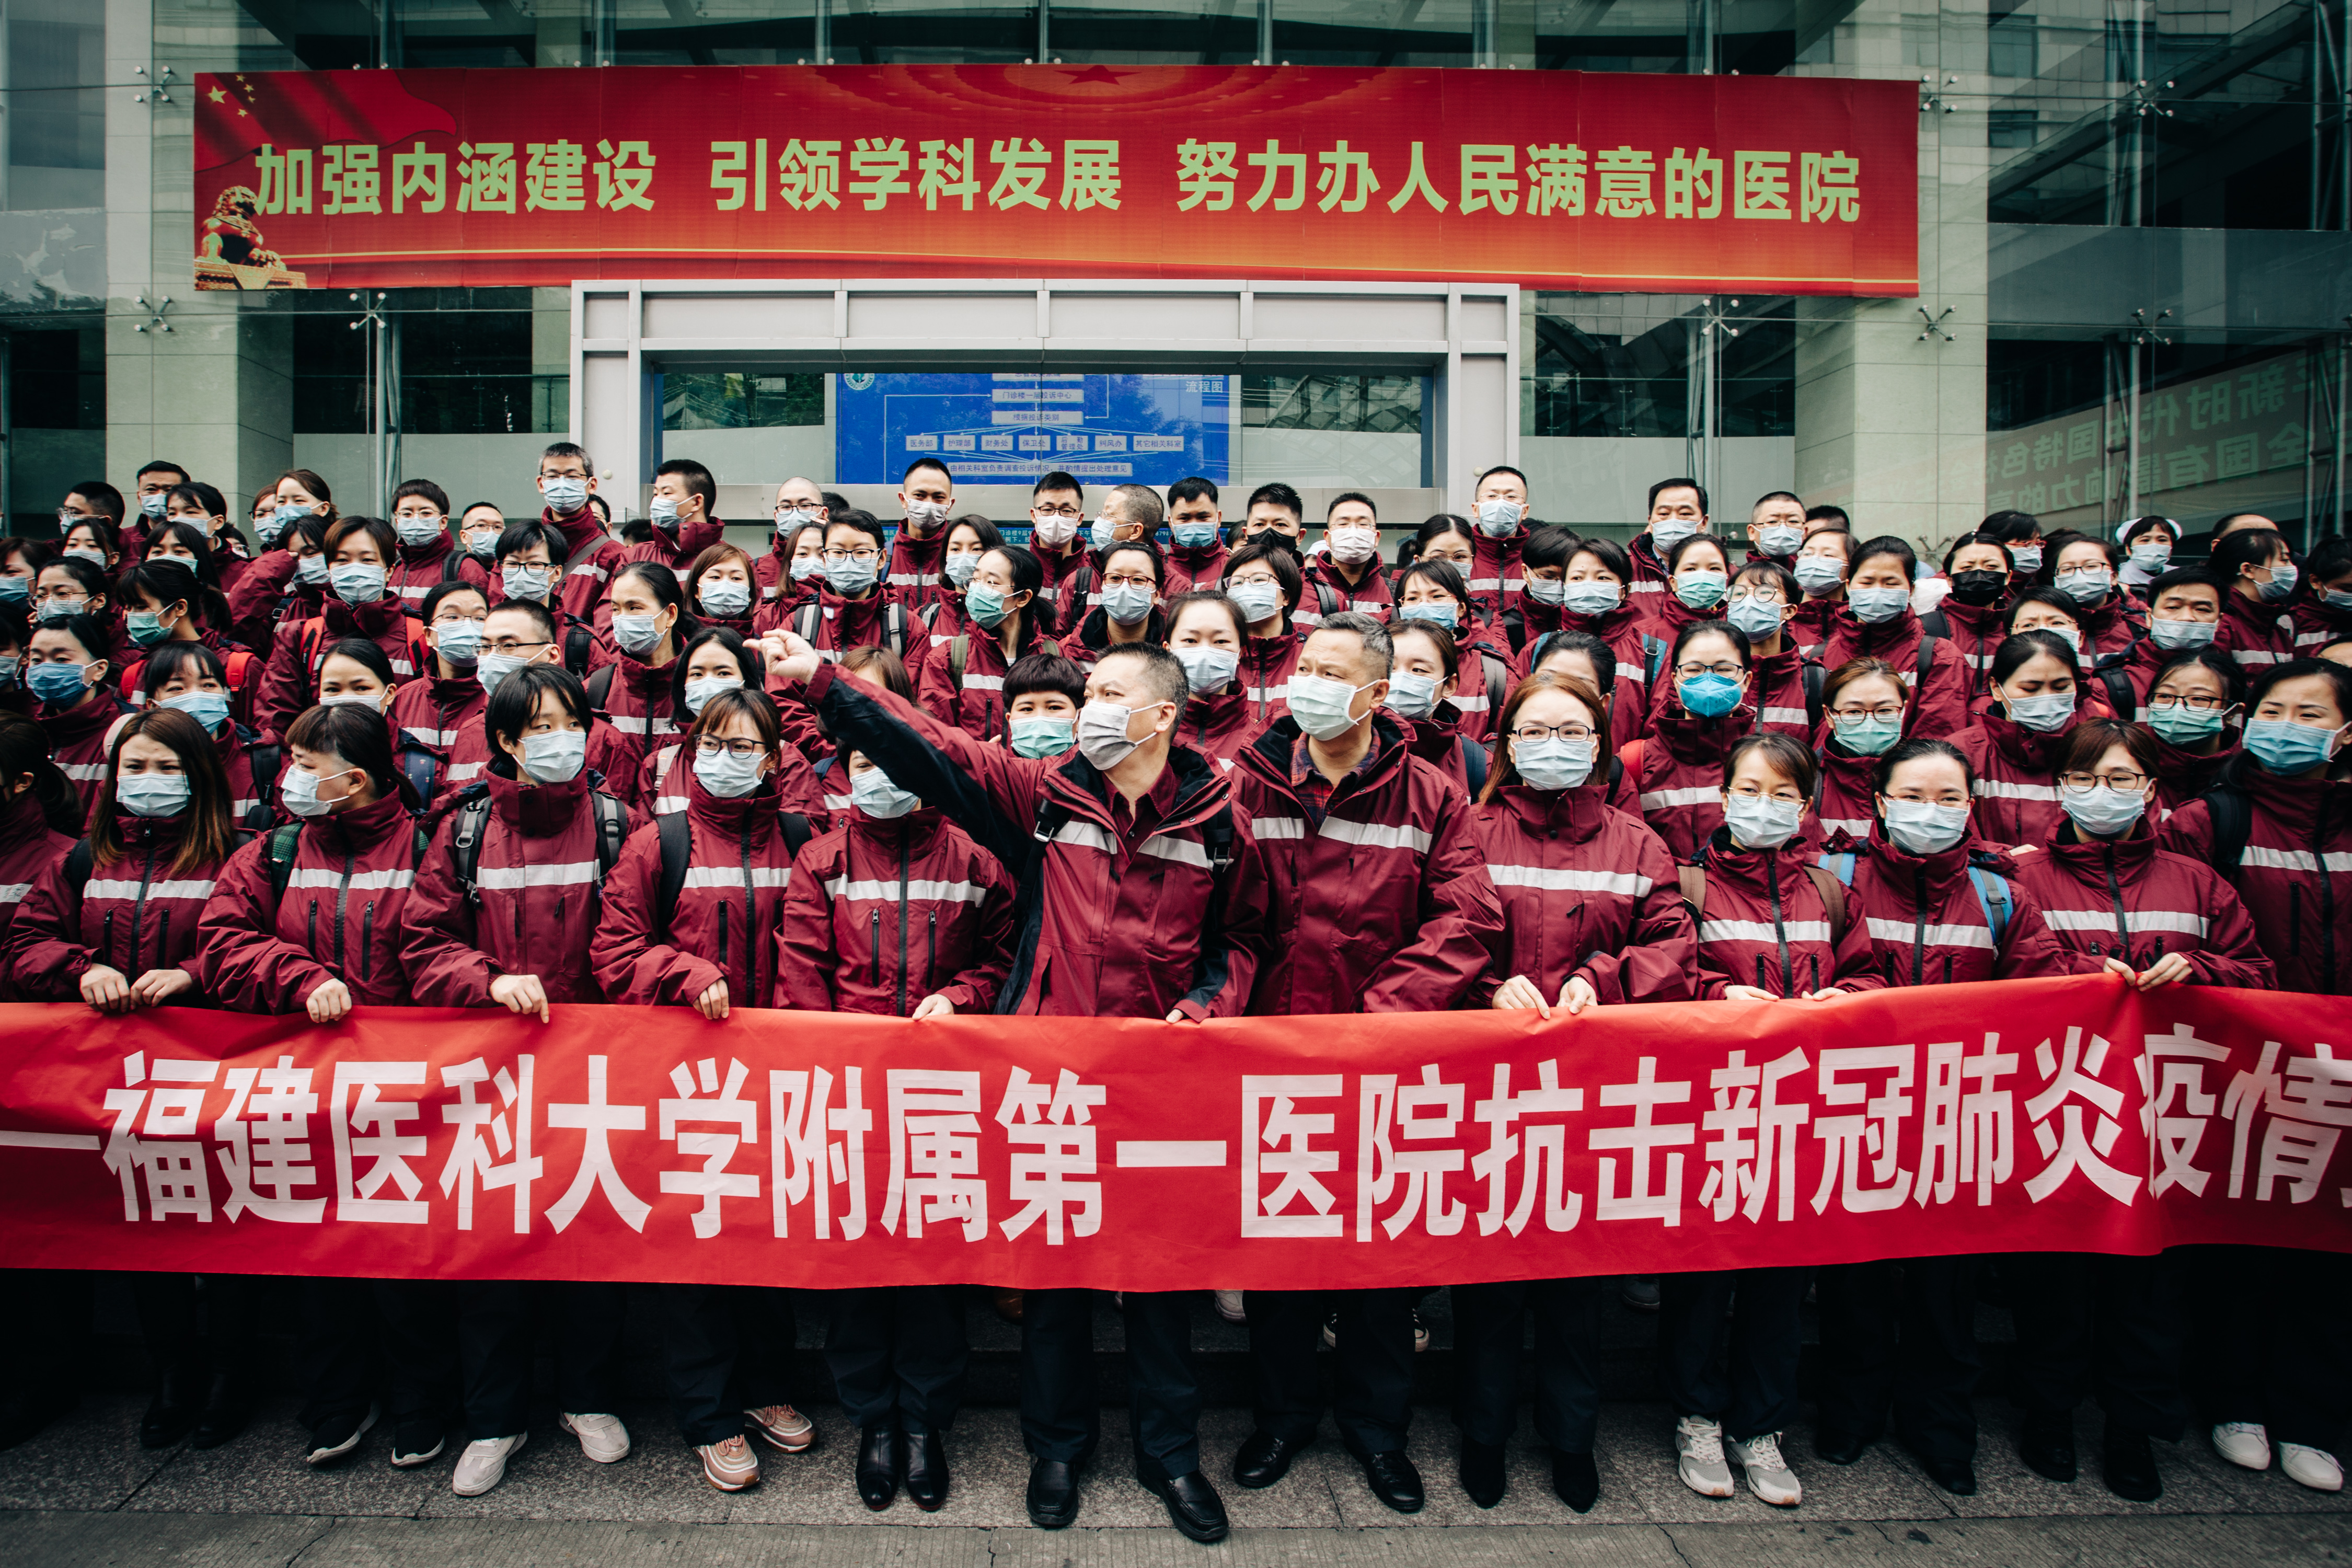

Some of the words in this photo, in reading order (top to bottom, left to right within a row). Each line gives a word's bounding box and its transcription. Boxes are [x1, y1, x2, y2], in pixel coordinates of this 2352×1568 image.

[254, 139, 656, 215] 加强内涵建设
[710, 137, 1122, 212] 引领学科发展
[1177, 139, 1860, 223] 努力办人民满意的医院
[1186, 381, 1223, 393] 流程图
[910, 439, 933, 447] 医务部
[948, 439, 971, 447] 护理部
[985, 439, 1008, 447] 财务处
[1022, 439, 1046, 447] 保卫处
